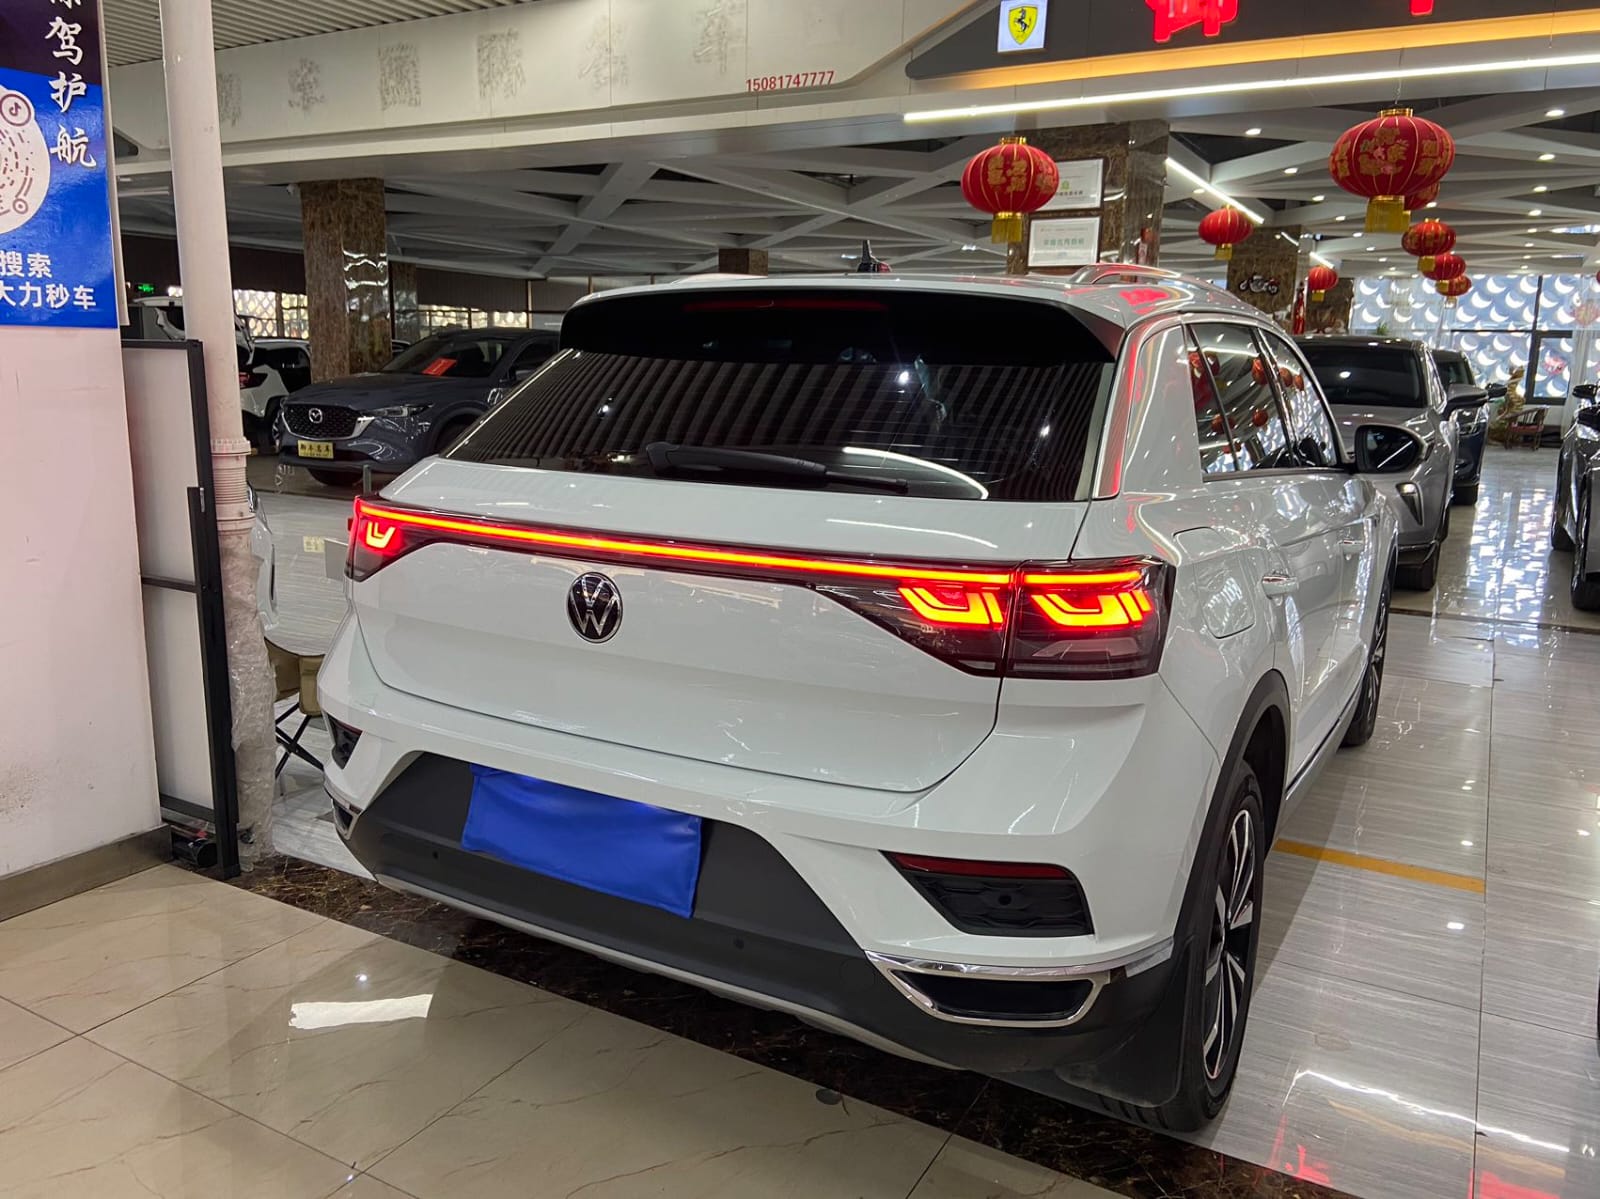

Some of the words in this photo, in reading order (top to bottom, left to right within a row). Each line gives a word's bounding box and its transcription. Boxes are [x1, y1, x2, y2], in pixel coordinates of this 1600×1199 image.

[746, 70, 835, 93] 15081747777
[0, 279, 97, 310] 大力秒车
